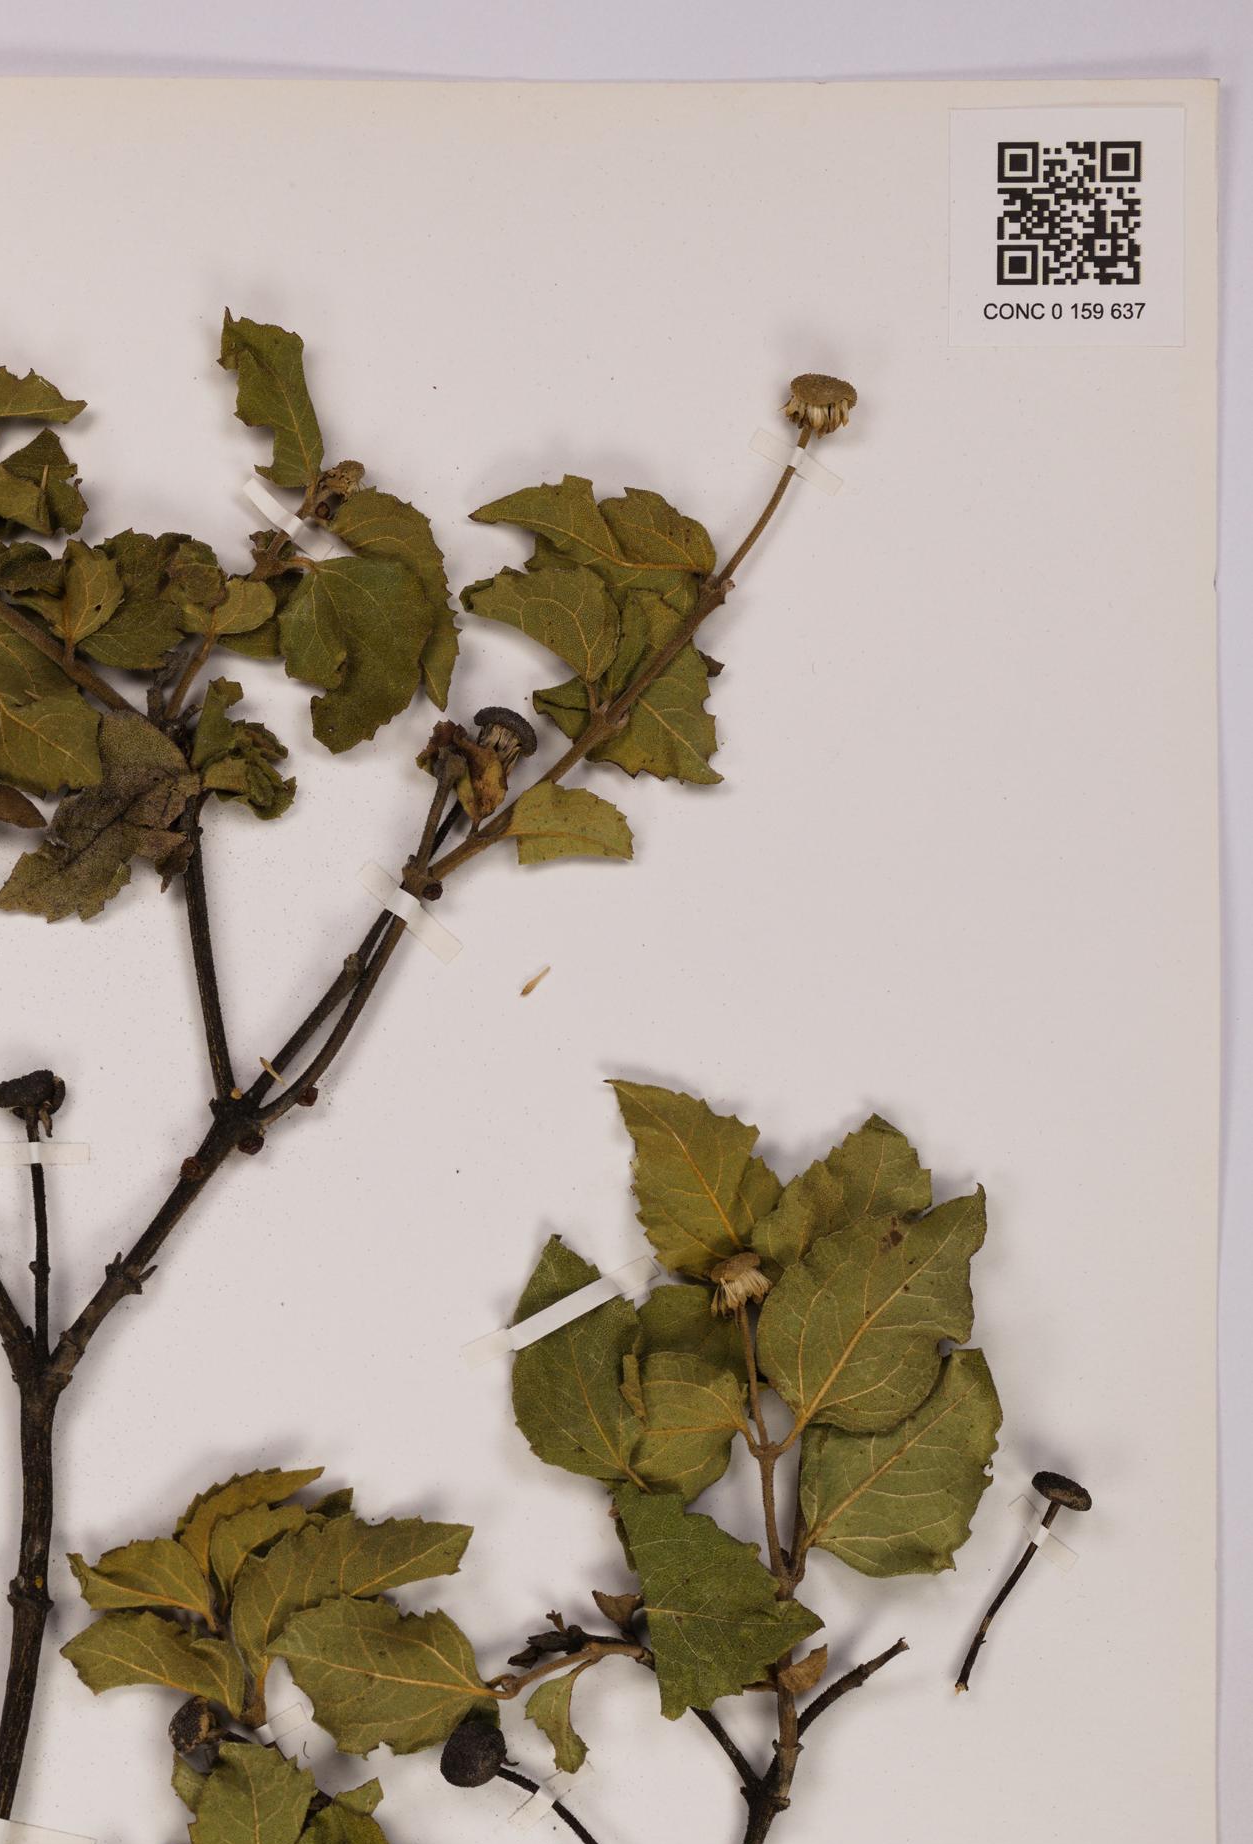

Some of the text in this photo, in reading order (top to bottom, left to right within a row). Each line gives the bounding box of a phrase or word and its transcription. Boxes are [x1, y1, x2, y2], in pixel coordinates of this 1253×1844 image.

[983, 302, 1146, 320] CONC 0 159 637
